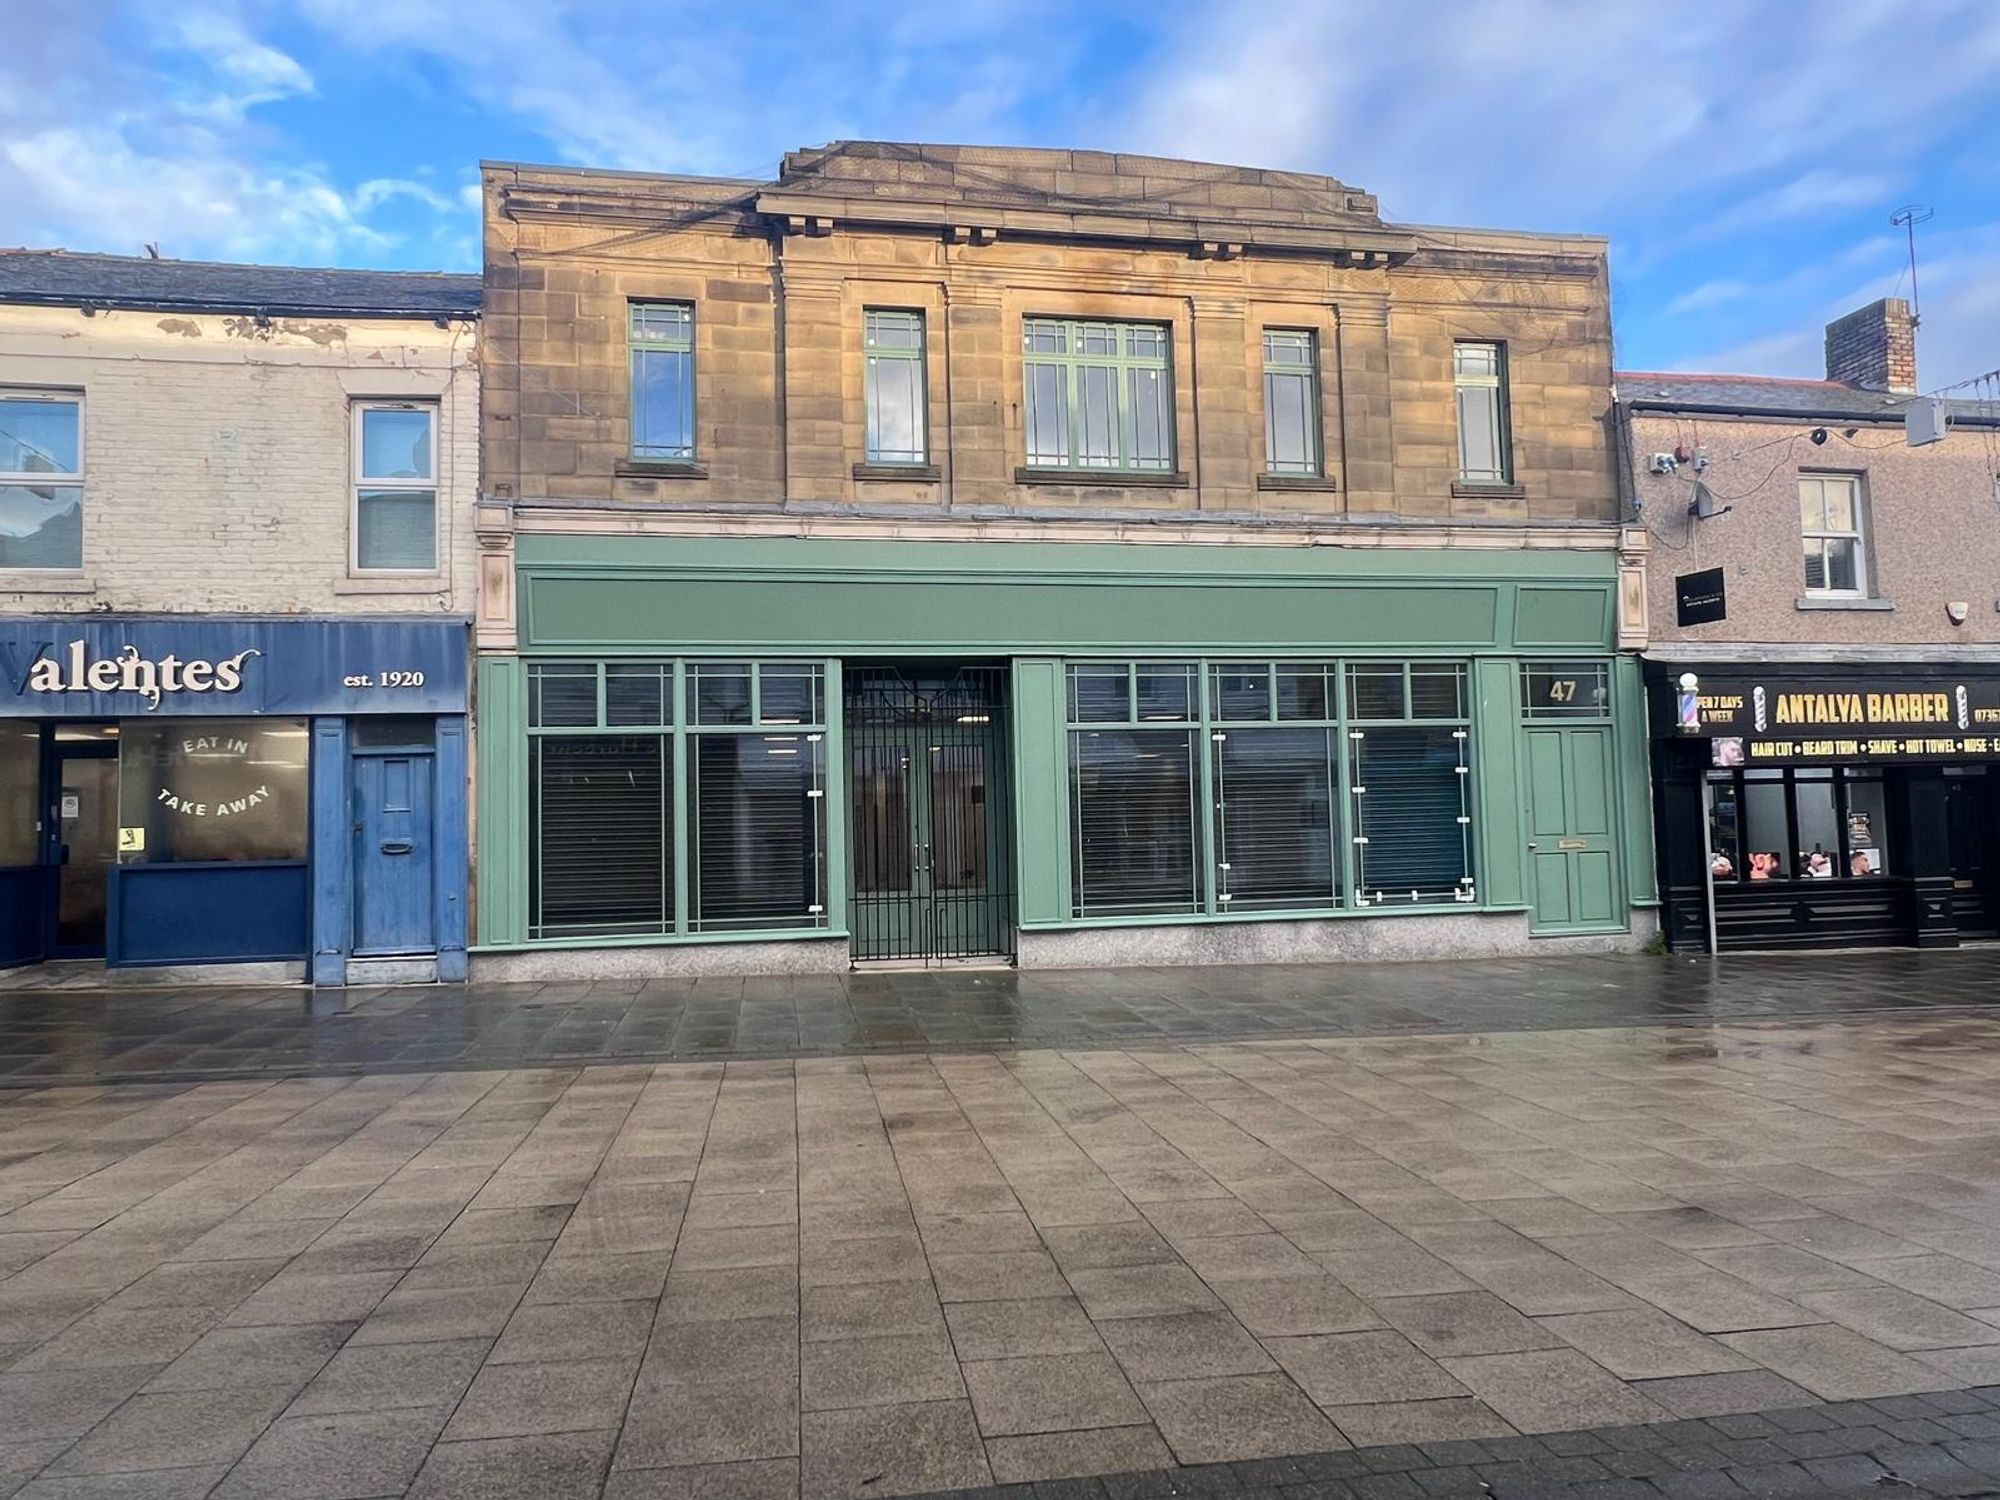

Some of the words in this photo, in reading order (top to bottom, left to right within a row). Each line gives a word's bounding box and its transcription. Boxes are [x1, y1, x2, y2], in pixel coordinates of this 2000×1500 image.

[343, 674, 373, 687] est.
[380, 671, 425, 687] 1920
[1550, 681, 1576, 701] 47
[1696, 696, 1713, 709] PEN
[1713, 696, 1719, 709] 7
[1719, 696, 1744, 709] DAYS
[1776, 694, 1864, 724] ANTALYA
[1866, 693, 1949, 723] BARBER
[1701, 710, 1708, 723] A
[1708, 710, 1734, 723] WEEK
[183, 736, 219, 753] EAT
[227, 738, 248, 754] IN
[1751, 742, 1775, 757] HAIR
[1775, 741, 1793, 757] CUT
[1802, 741, 1834, 756] BEARD
[1834, 740, 1858, 755] TRIM
[1867, 740, 1898, 754] SHAVE
[1905, 739, 1924, 754] HOT
[1924, 738, 1957, 754] TOWEL
[157, 788, 207, 816] TAKE
[216, 785, 270, 816] AWAY
